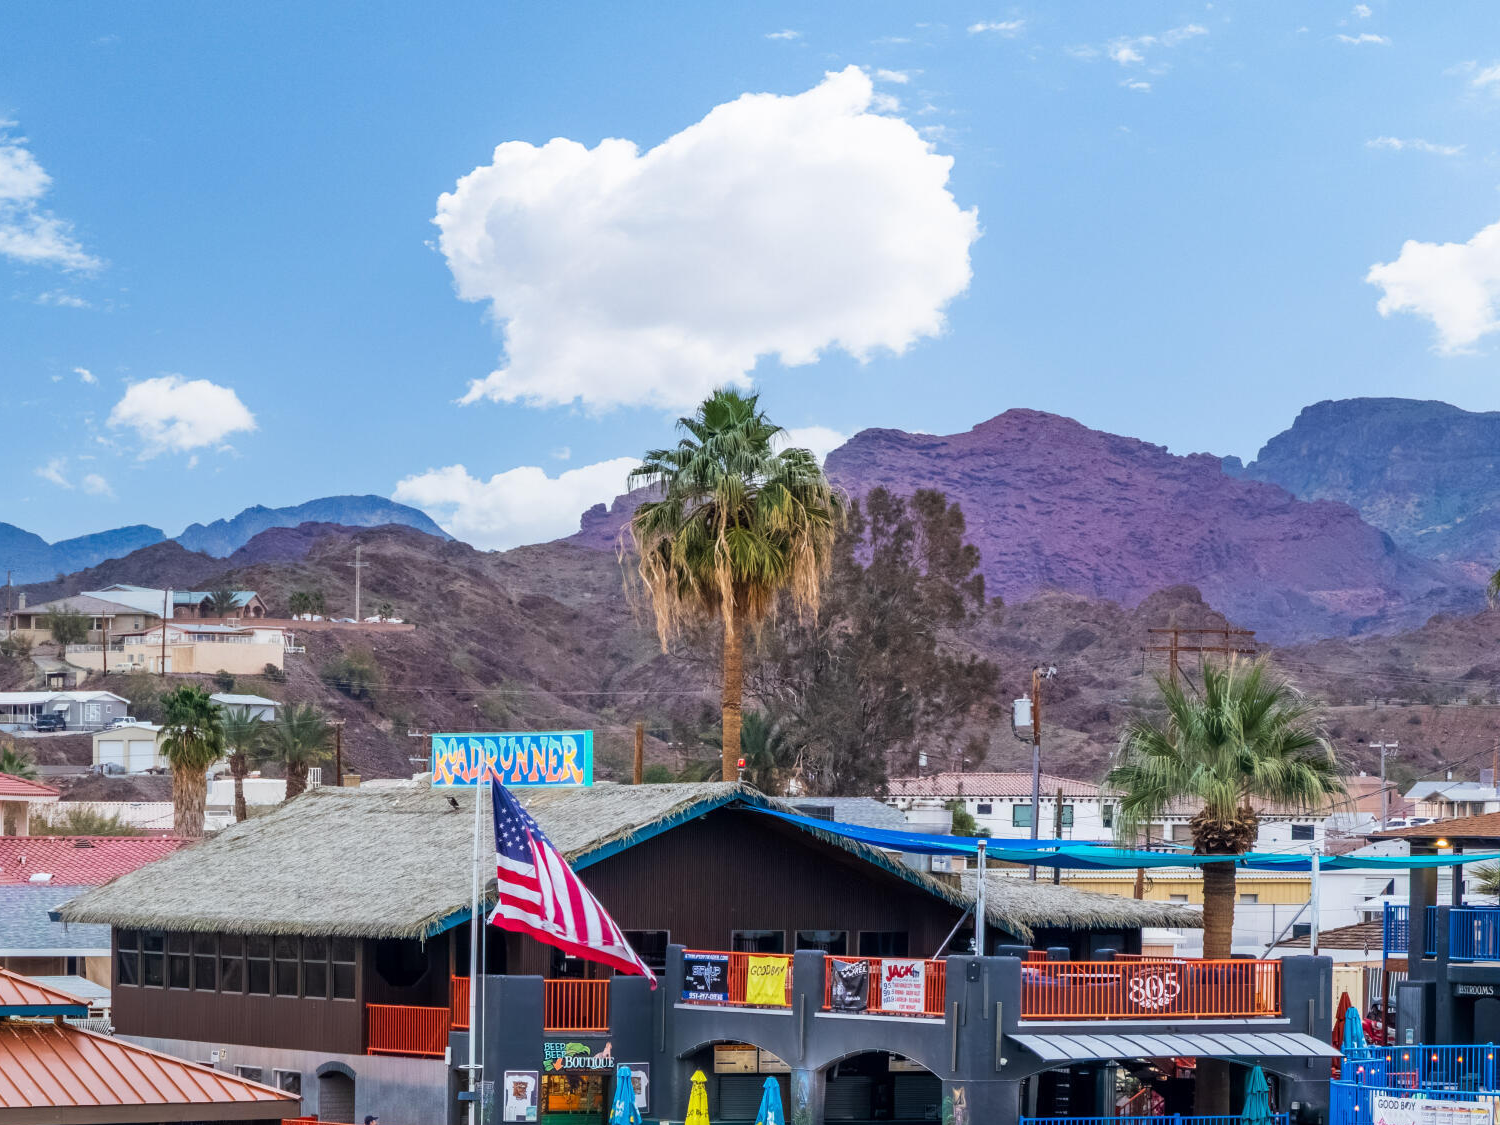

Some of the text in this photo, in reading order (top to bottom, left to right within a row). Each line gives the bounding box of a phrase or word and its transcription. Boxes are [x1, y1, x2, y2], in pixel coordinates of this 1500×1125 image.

[433, 736, 584, 785] ROADRUNNER
[750, 965, 771, 976] GOOD
[886, 964, 914, 982] JACK
[1129, 972, 1181, 1003] 805
[544, 1043, 566, 1052] BEEP
[545, 1051, 567, 1060] BEEP
[563, 1056, 615, 1069] BOUTIQUE
[1378, 1099, 1416, 1111] GOOD BOY
